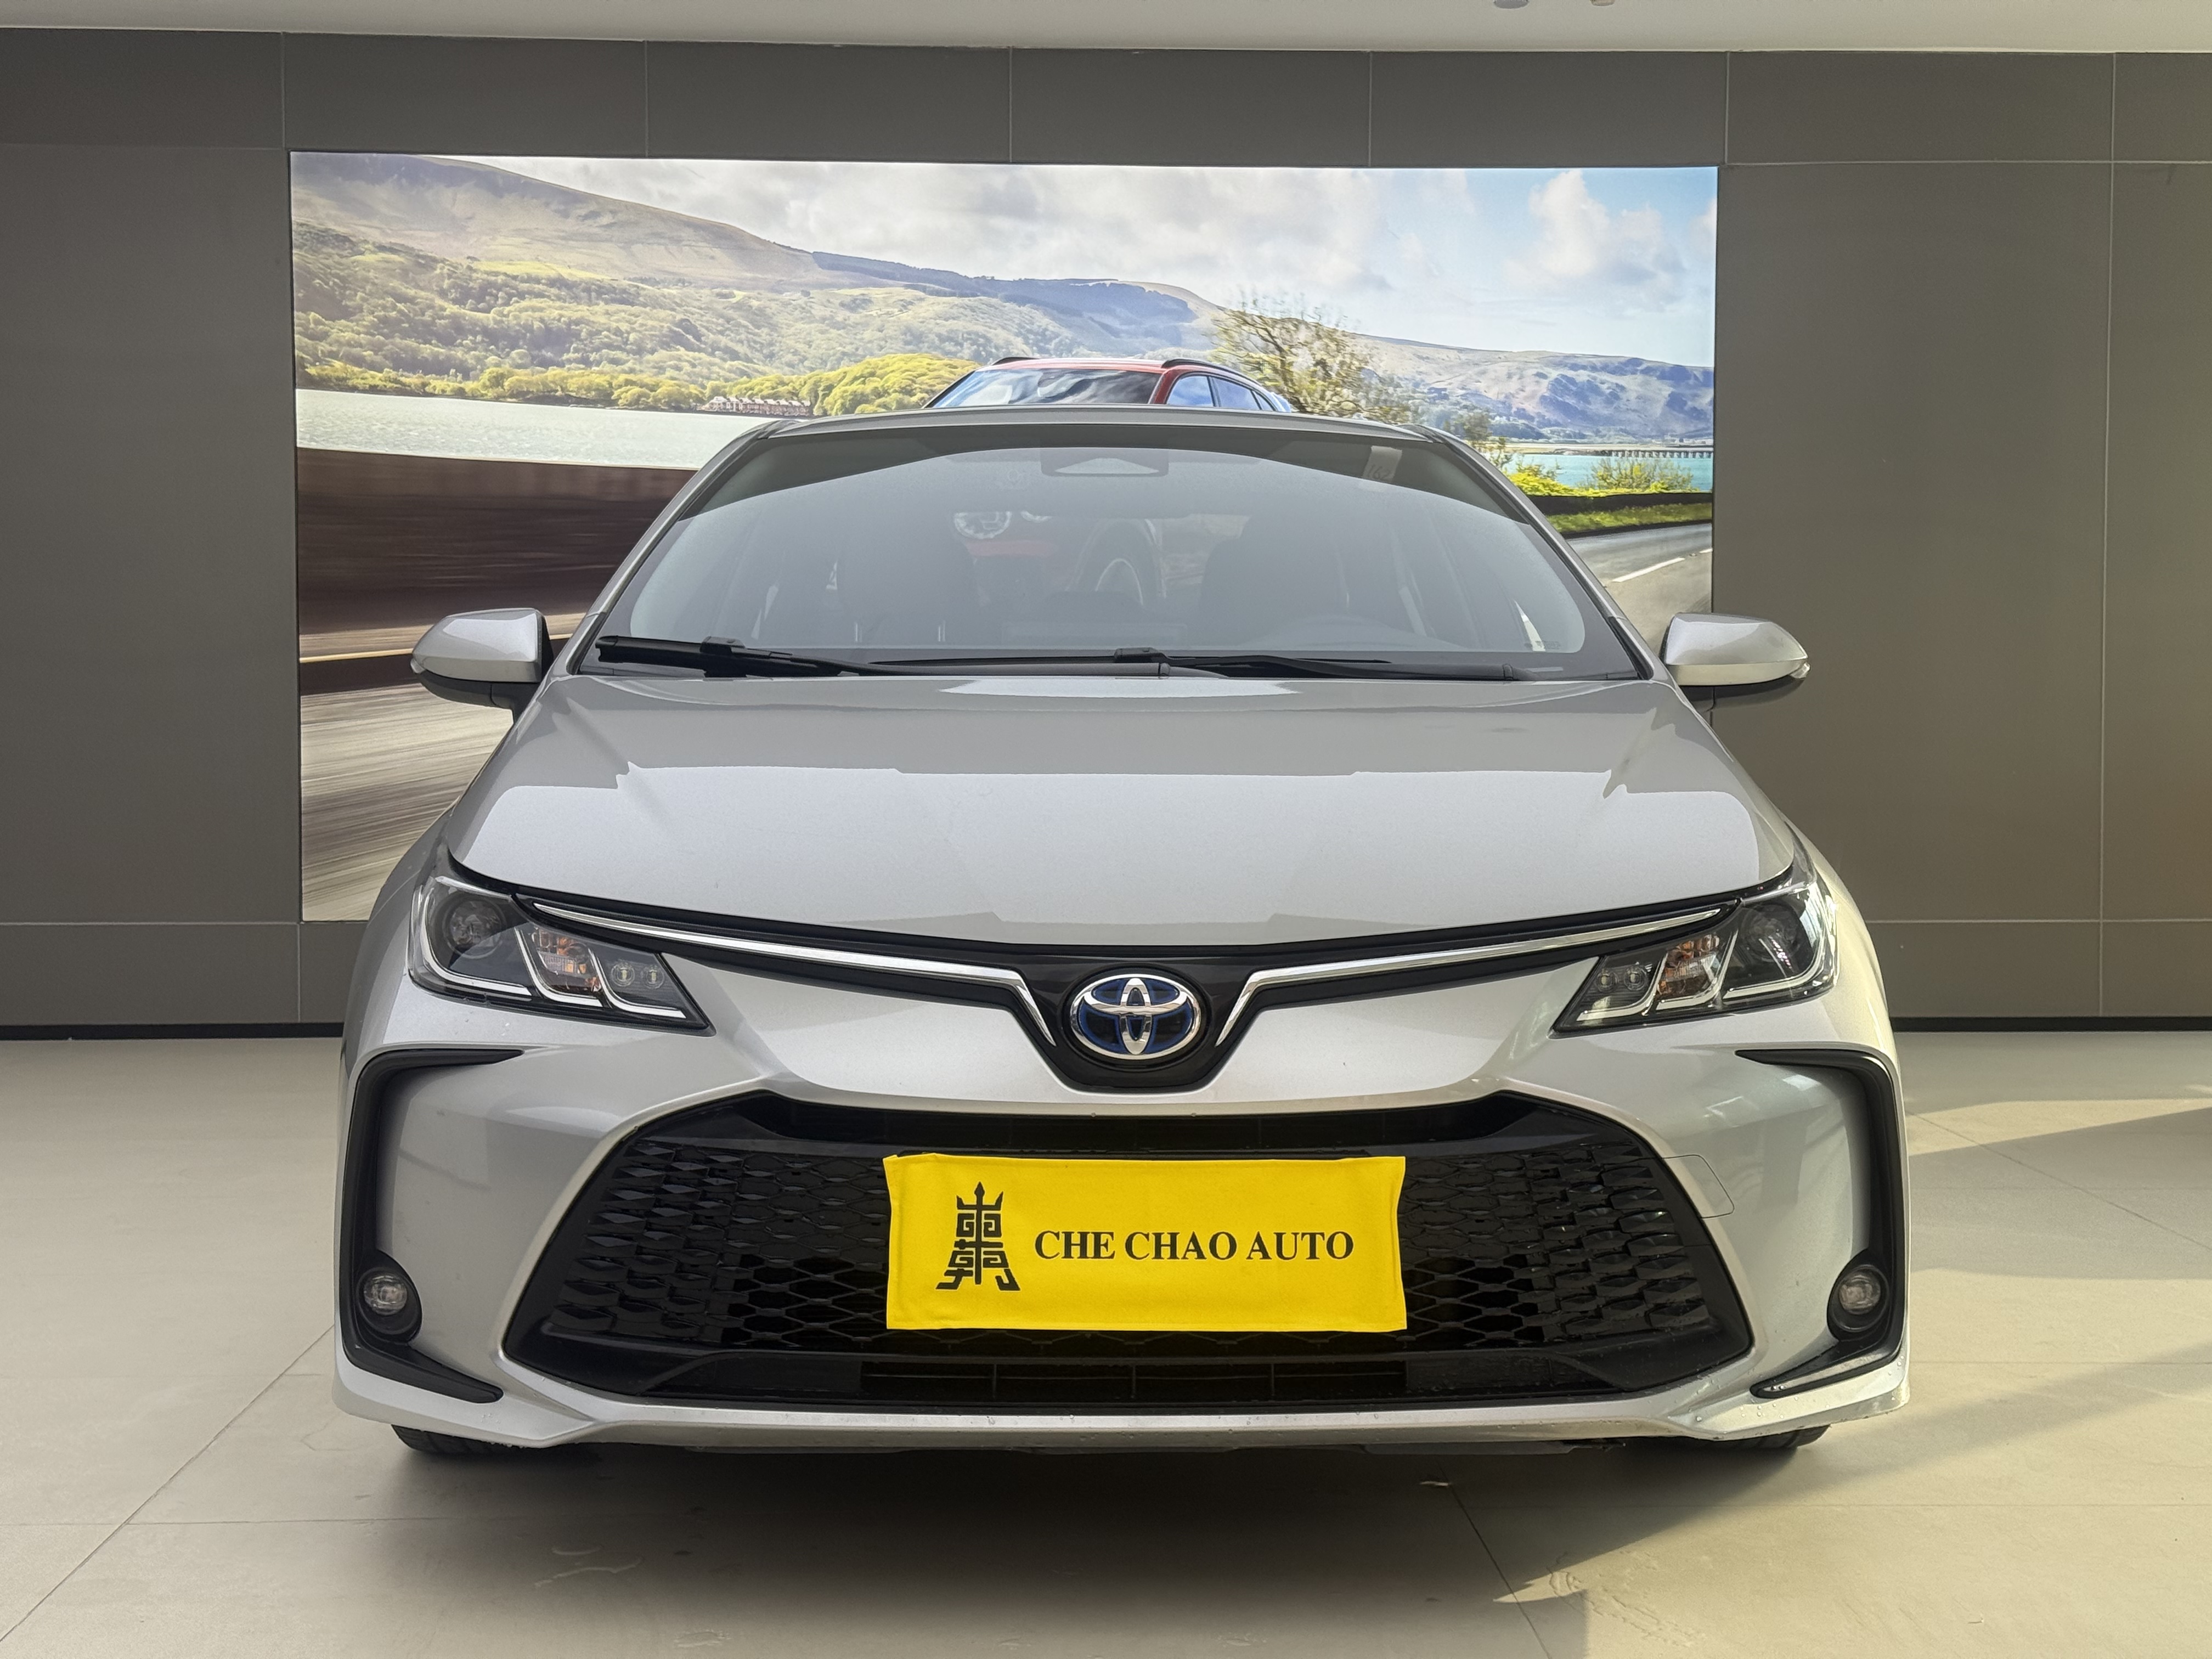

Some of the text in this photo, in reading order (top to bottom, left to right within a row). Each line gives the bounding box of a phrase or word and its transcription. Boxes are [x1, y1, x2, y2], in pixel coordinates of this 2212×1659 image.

[1035, 1231, 1354, 1261] CHE CHAO AUTO
